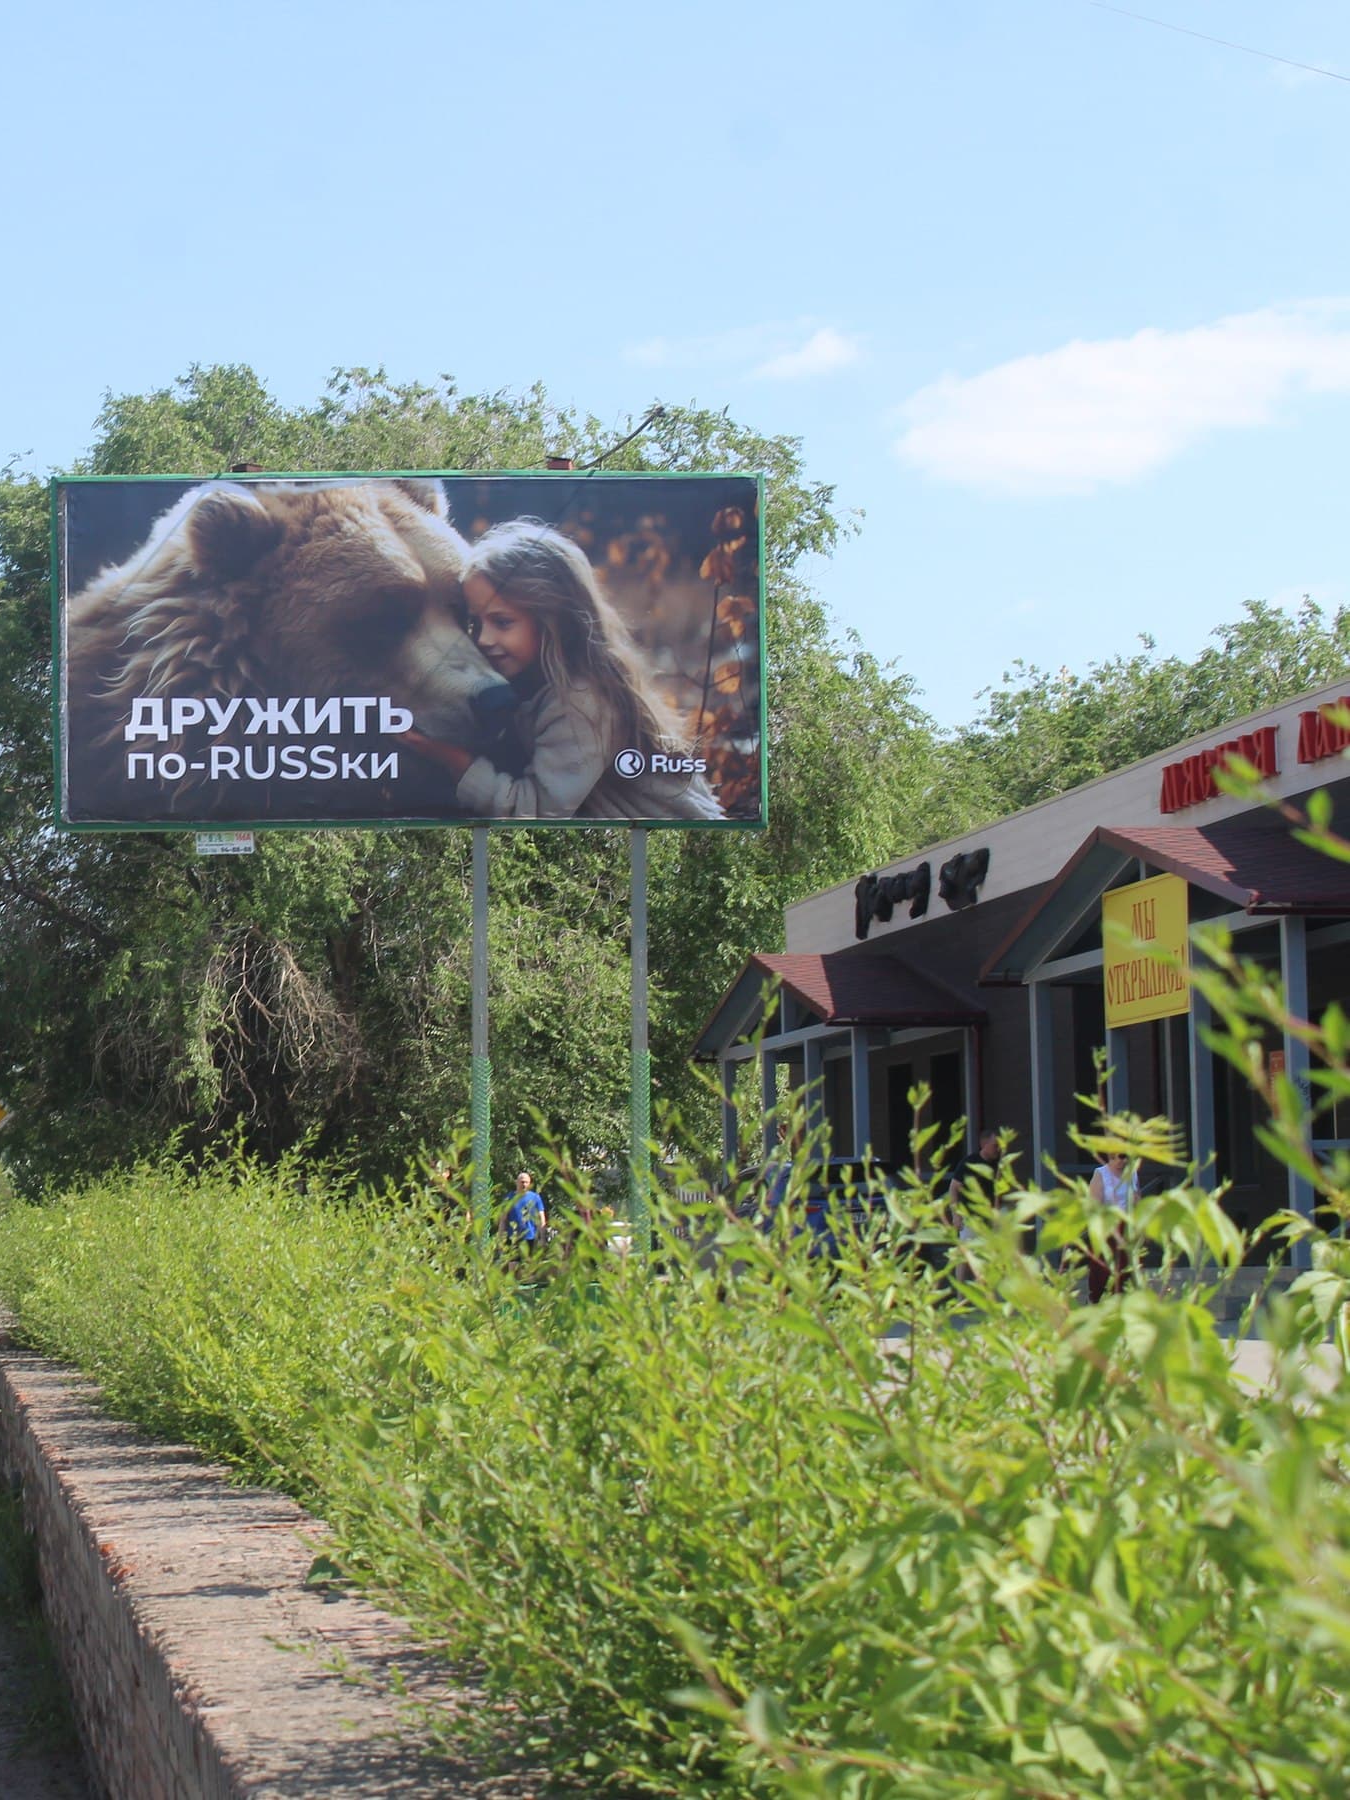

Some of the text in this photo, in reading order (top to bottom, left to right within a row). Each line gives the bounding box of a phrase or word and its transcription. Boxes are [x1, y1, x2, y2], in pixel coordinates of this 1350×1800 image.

[124, 697, 414, 741] ДРУЖИТЬ
[127, 745, 399, 780] по-RUSSки
[651, 754, 706, 773] Russ
[1132, 898, 1156, 941] МЫ
